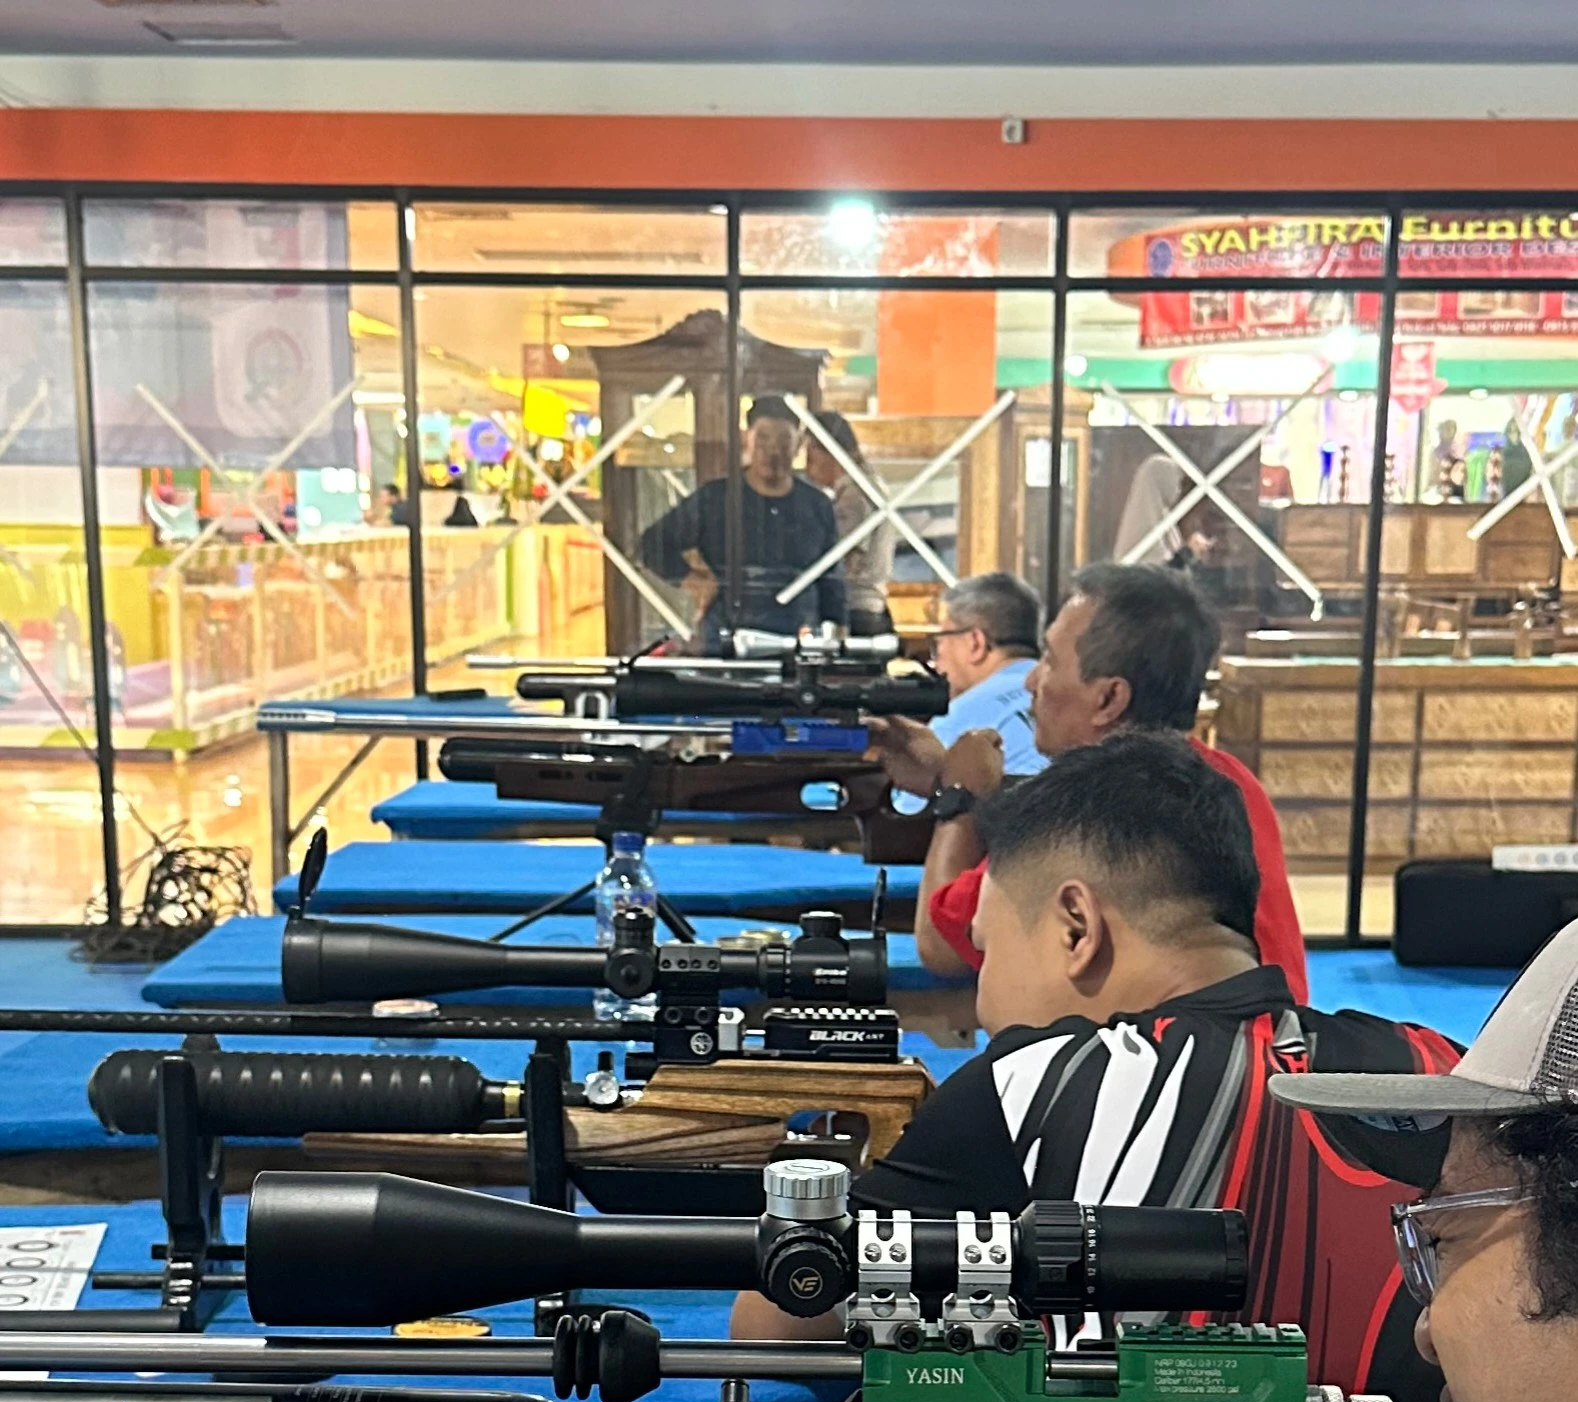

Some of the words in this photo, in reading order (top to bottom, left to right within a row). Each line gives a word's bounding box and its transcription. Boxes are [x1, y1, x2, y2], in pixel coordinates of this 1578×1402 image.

[809, 1030, 866, 1041] BLACK
[1087, 1267, 1096, 1277] 12
[905, 1367, 965, 1384] YASIN
